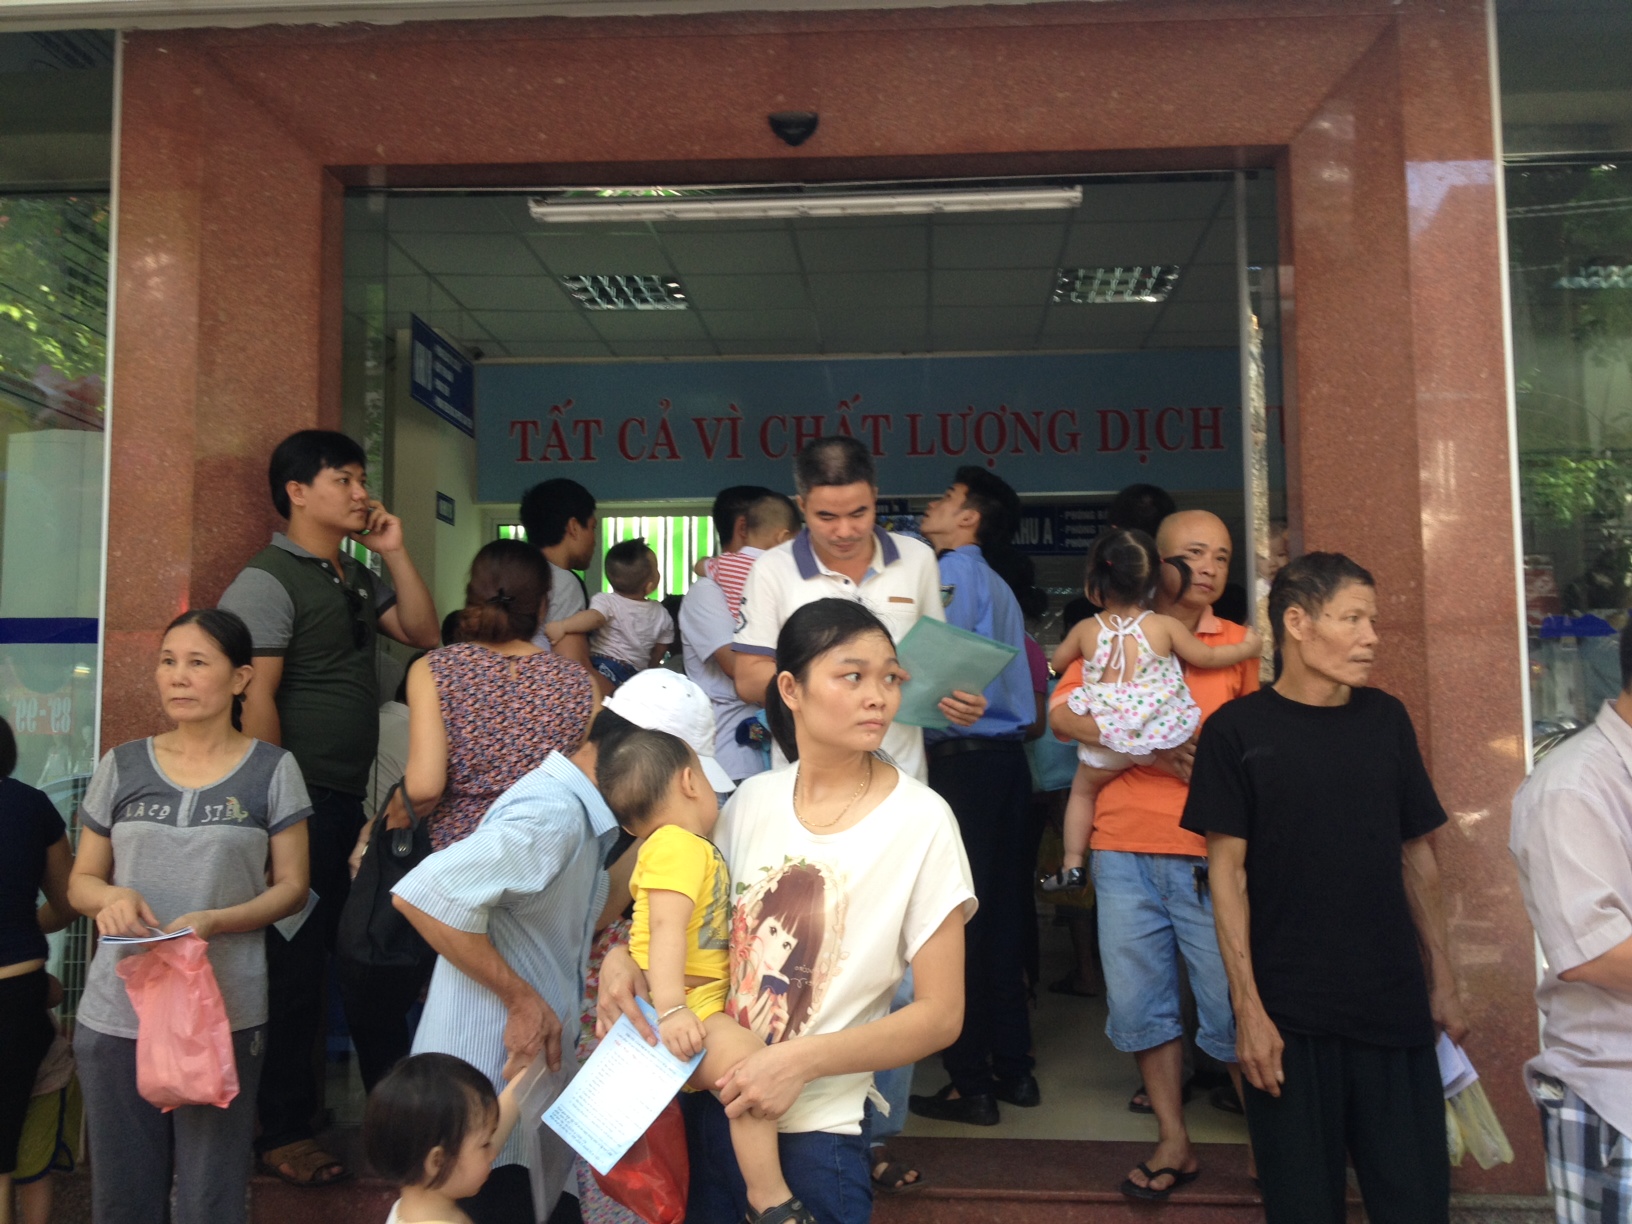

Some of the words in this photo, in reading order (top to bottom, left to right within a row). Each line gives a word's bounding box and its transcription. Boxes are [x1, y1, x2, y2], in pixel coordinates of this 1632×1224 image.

[510, 399, 602, 462] TẤT
[618, 399, 681, 461] CẢ
[692, 402, 744, 459] VÌ
[906, 405, 1082, 468] LƯỢNG
[1097, 406, 1225, 463] DỊCH
